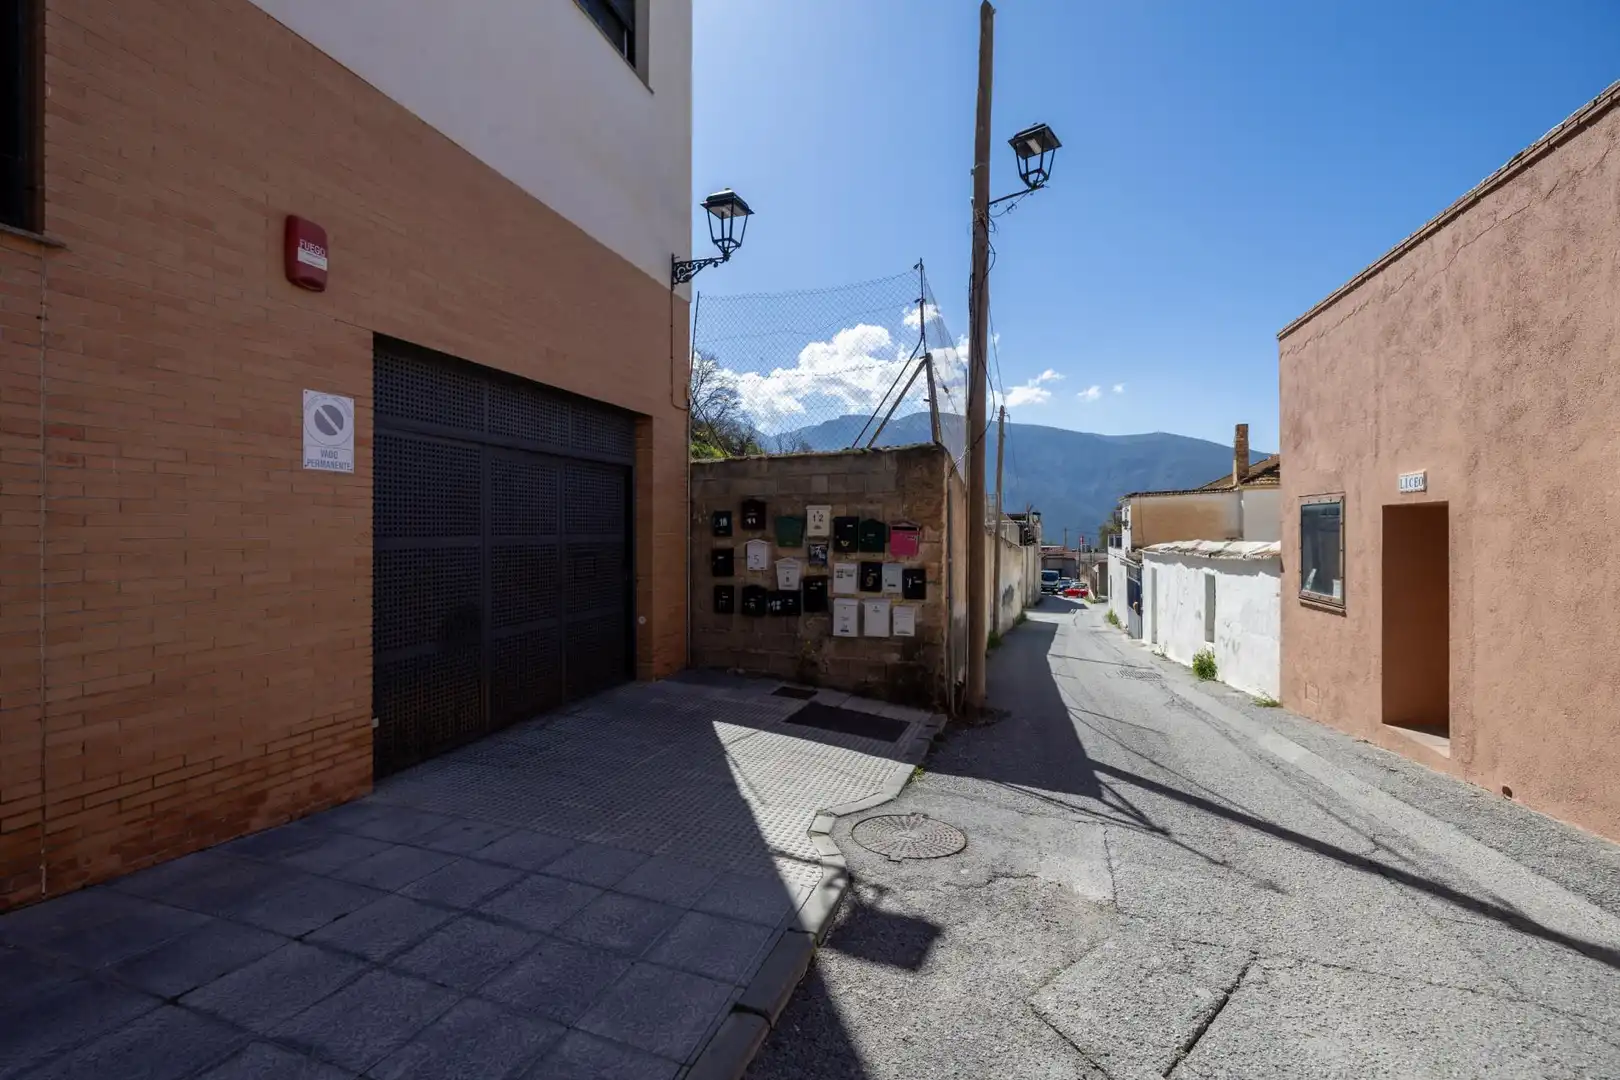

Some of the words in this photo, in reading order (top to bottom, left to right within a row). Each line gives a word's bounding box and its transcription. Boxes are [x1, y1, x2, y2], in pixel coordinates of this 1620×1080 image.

[299, 239, 326, 257] FUEGO
[320, 449, 339, 460] VADO
[306, 458, 351, 471] PERMANENTE
[1399, 476, 1424, 489] LICEO
